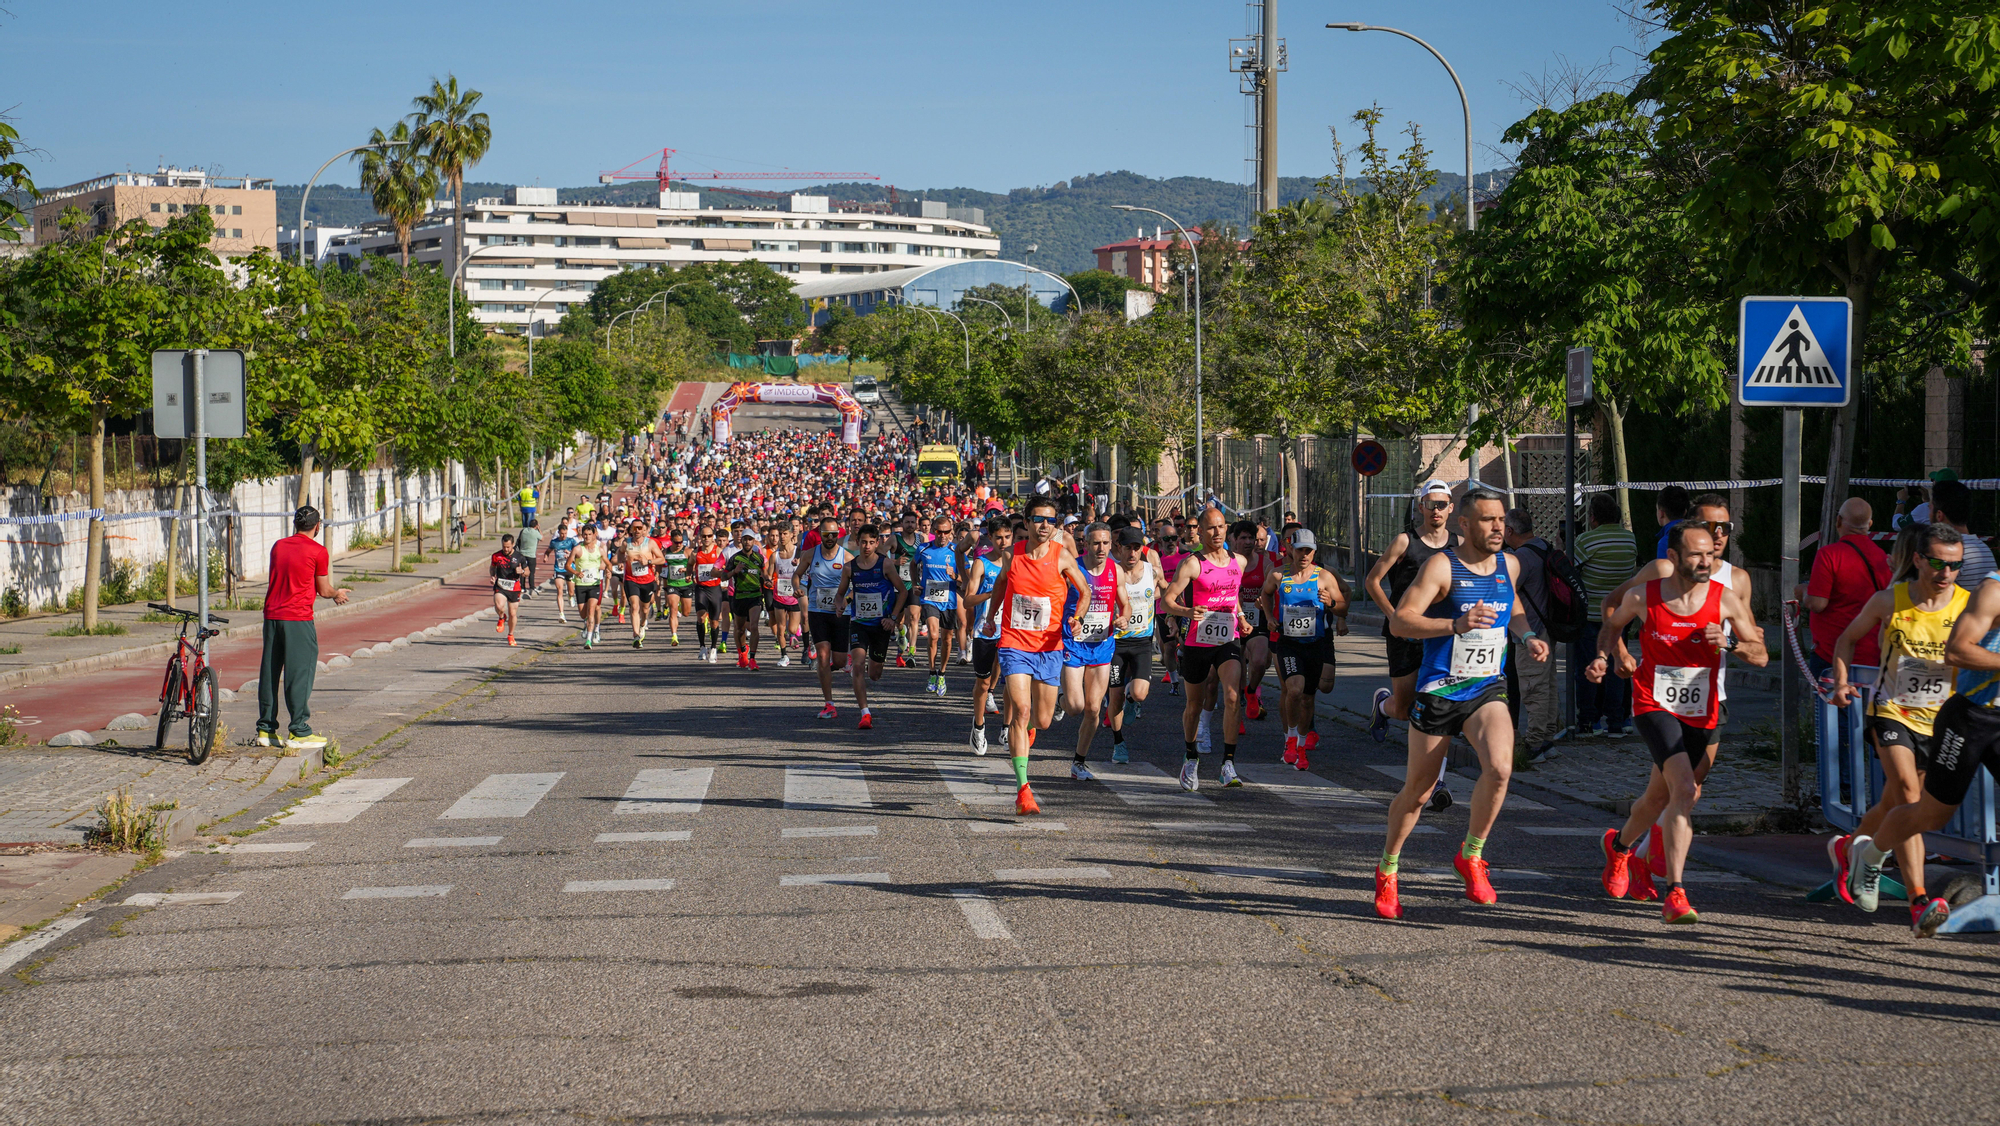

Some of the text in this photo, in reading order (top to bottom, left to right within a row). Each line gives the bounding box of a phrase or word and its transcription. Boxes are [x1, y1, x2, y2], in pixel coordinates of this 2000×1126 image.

[774, 388, 810, 396] IMDECO
[930, 588, 944, 597] 852
[860, 602, 878, 612] 524
[1024, 609, 1040, 621] 57
[1082, 624, 1104, 634] 873
[1288, 618, 1310, 629] 493
[1205, 623, 1228, 637] 610
[1906, 638, 1925, 647] CLUB
[1465, 647, 1495, 664] 751
[1907, 676, 1943, 694] 345
[1666, 686, 1701, 704] 986
